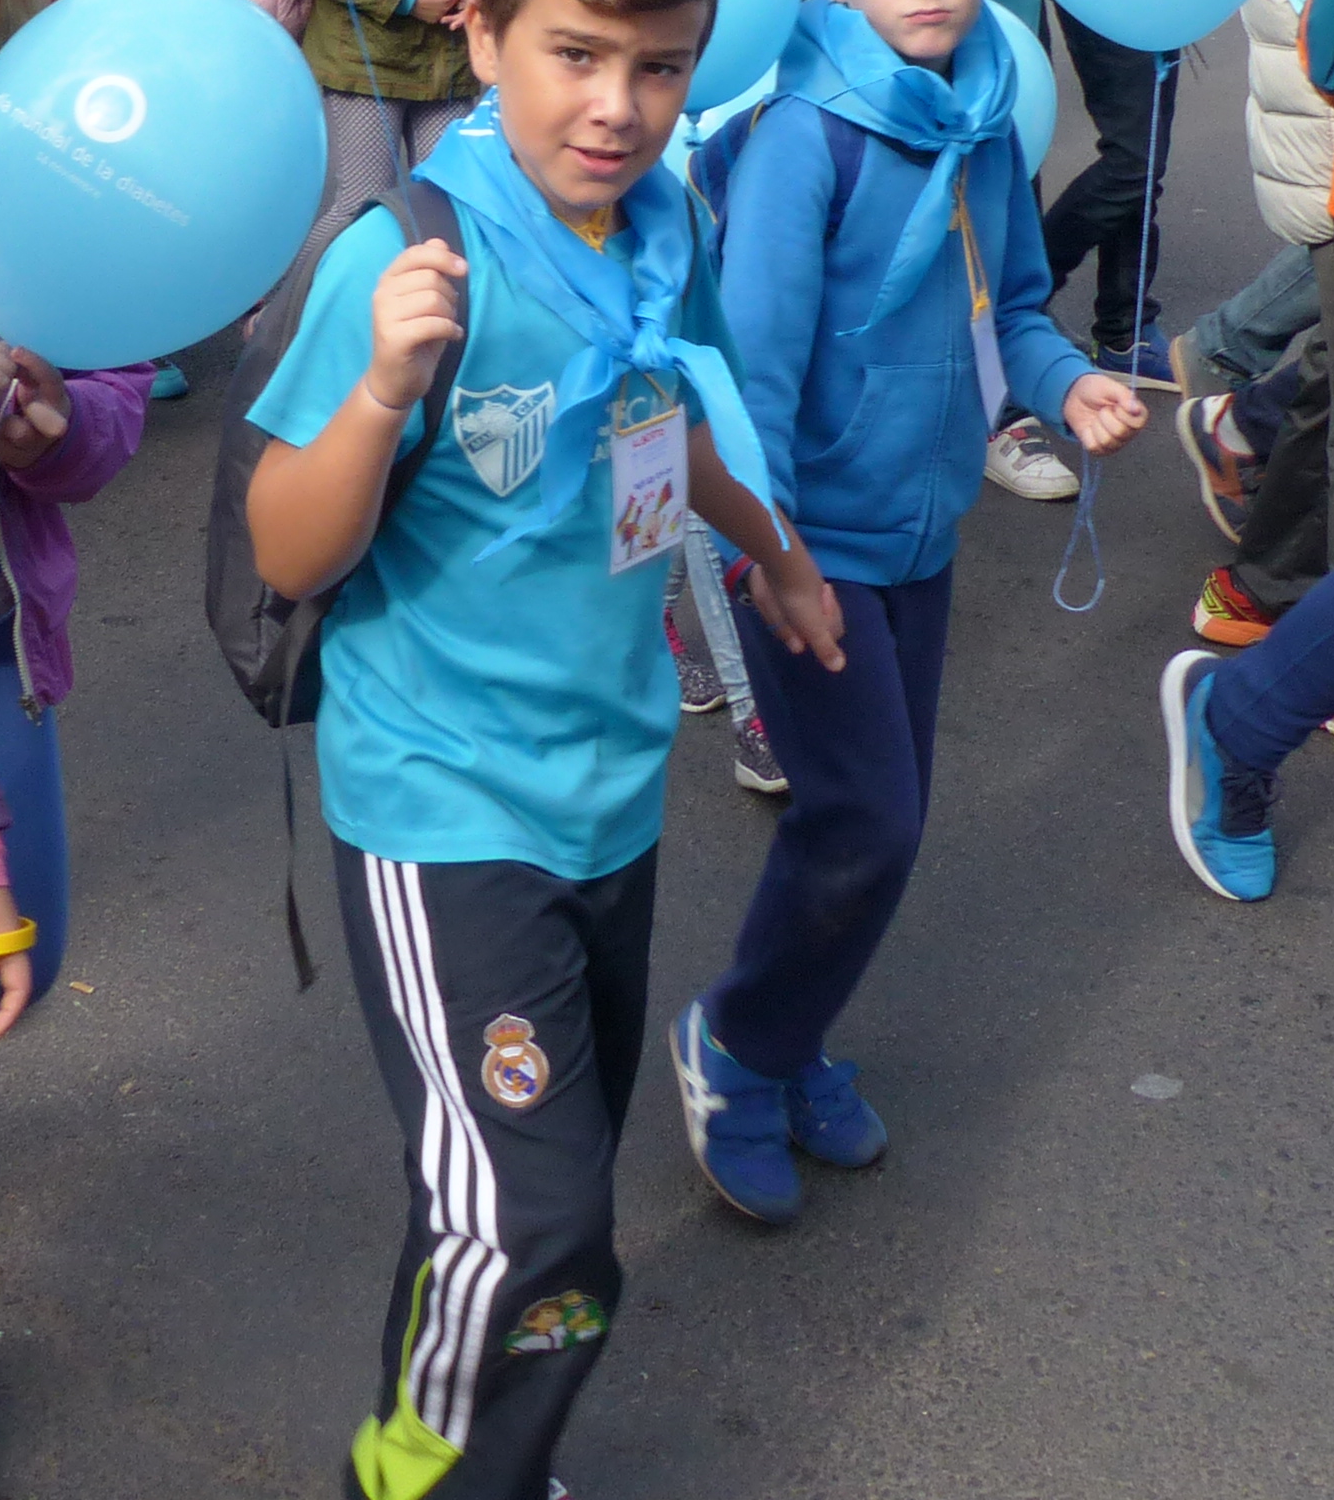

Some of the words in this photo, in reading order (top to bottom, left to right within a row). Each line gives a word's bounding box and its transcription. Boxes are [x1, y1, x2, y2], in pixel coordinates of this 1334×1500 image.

[71, 146, 94, 168] de
[95, 159, 115, 181] la
[116, 175, 191, 227] diabetes
